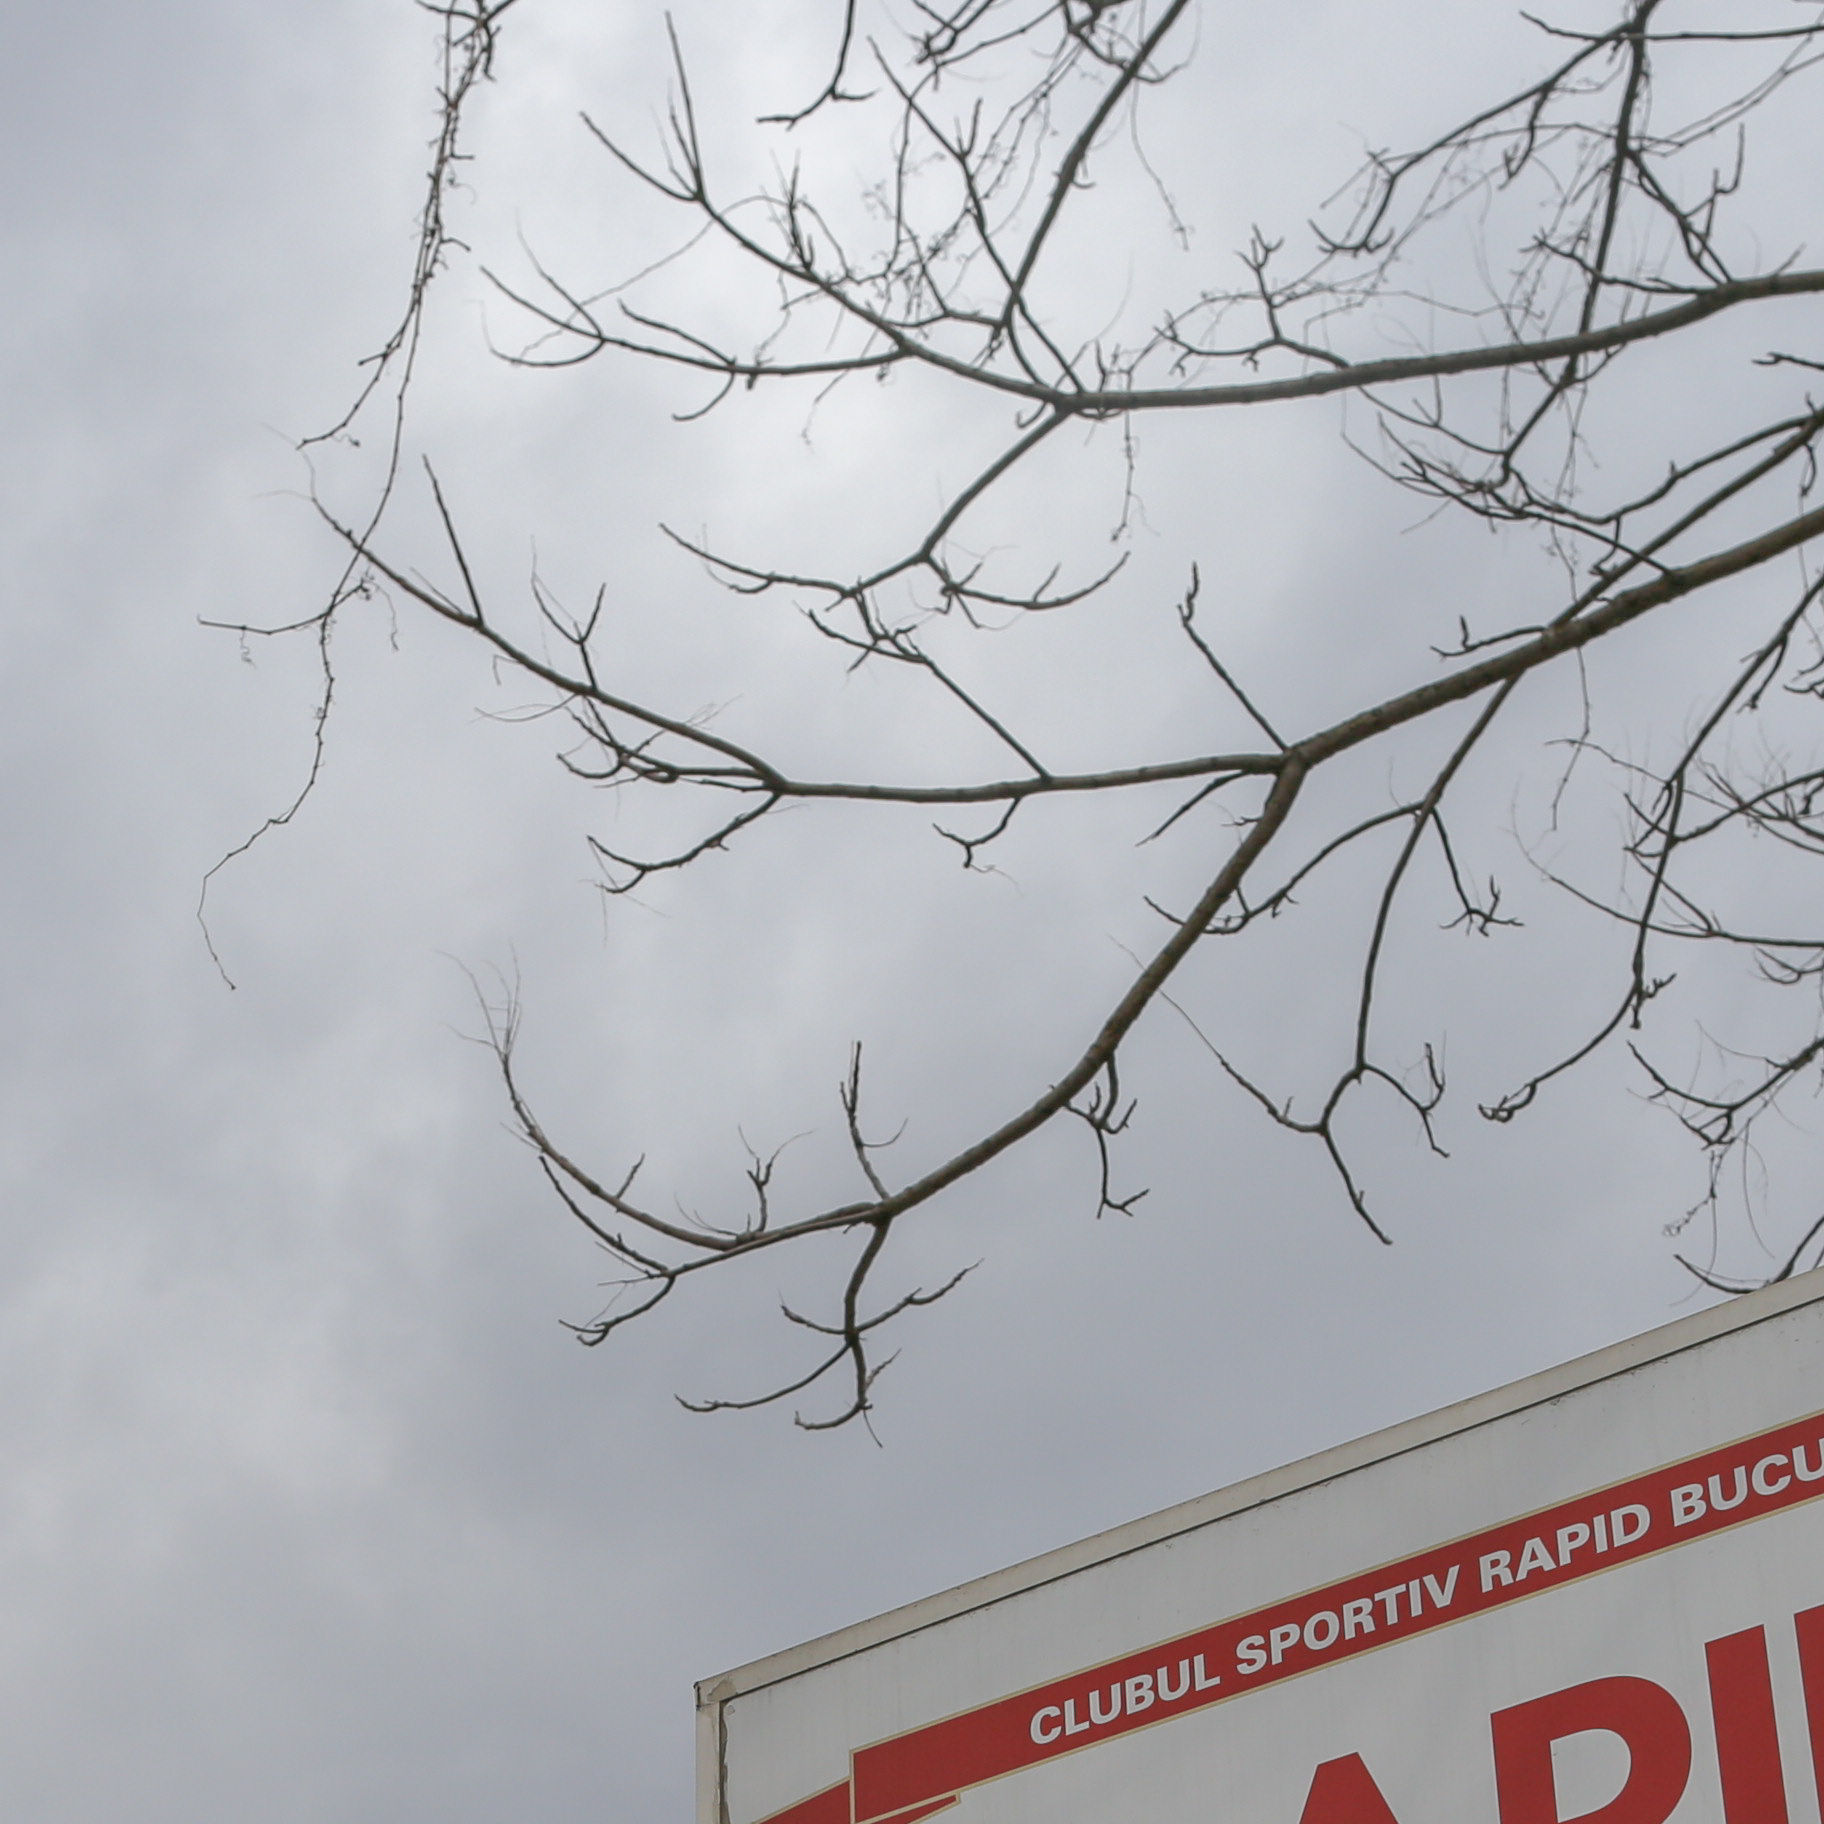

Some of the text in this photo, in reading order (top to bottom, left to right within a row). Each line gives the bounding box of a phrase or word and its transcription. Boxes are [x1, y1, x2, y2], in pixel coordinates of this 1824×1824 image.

[1029, 1653, 1221, 1745] CLUBUL
[1235, 1565, 1461, 1675] SPORTIV
[1478, 1503, 1651, 1593] RAPID
